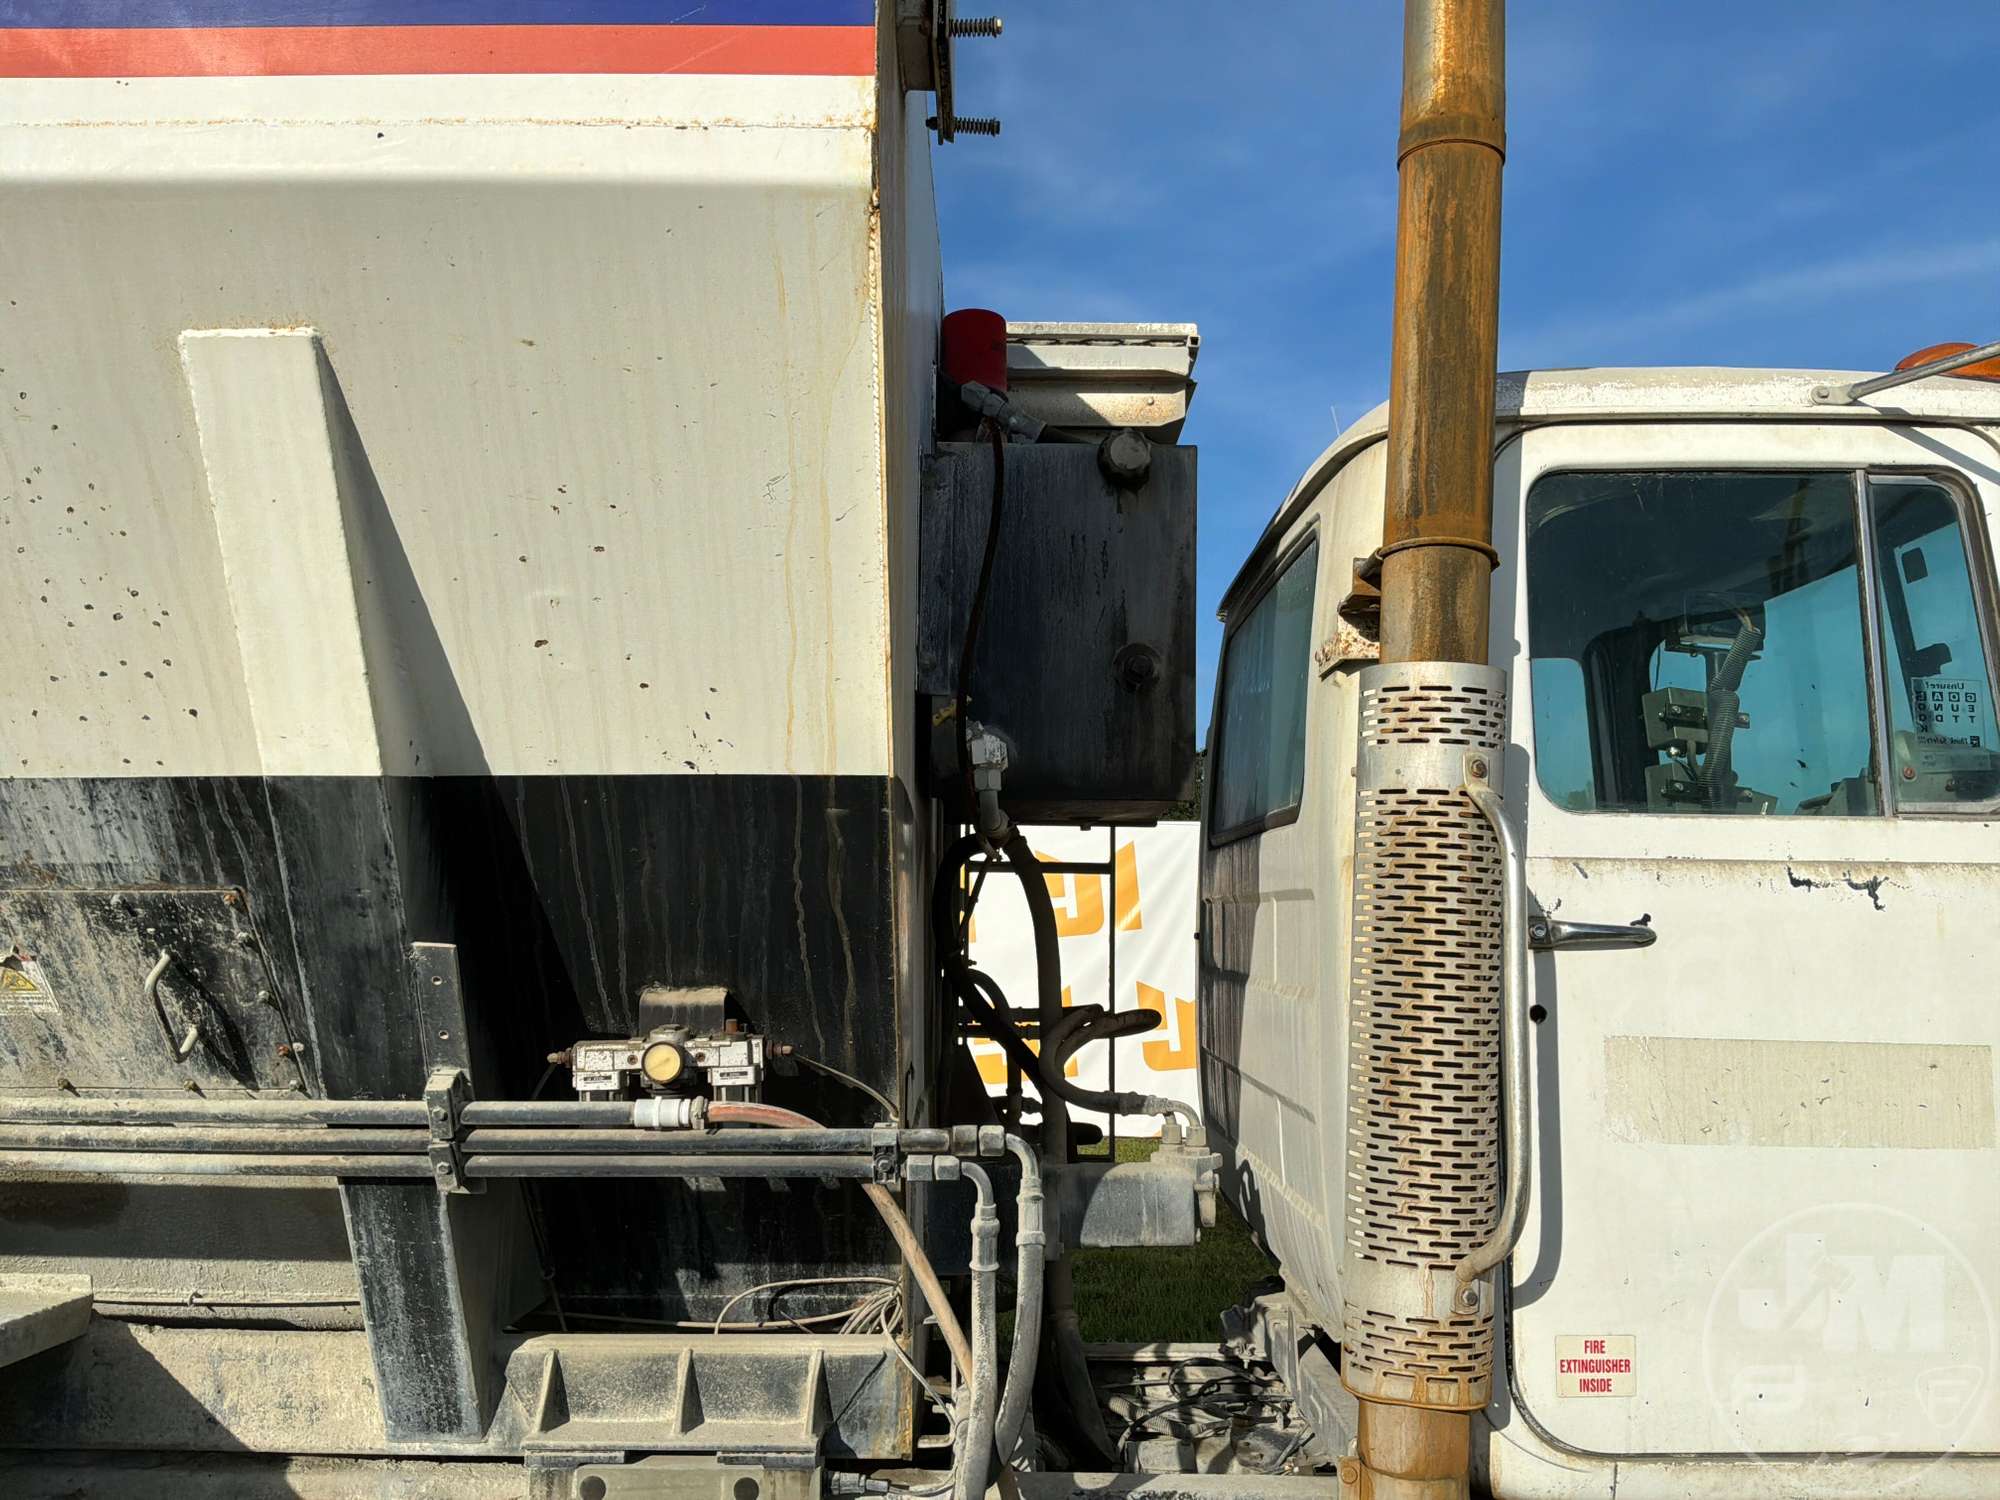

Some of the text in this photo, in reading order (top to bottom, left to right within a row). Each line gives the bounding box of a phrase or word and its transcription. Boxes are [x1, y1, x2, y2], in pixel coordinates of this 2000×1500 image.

[1584, 1340, 1606, 1354] FIRE
[1560, 1359, 1631, 1374] EXTINGUISHER
[1579, 1378, 1613, 1393] INSIDE
